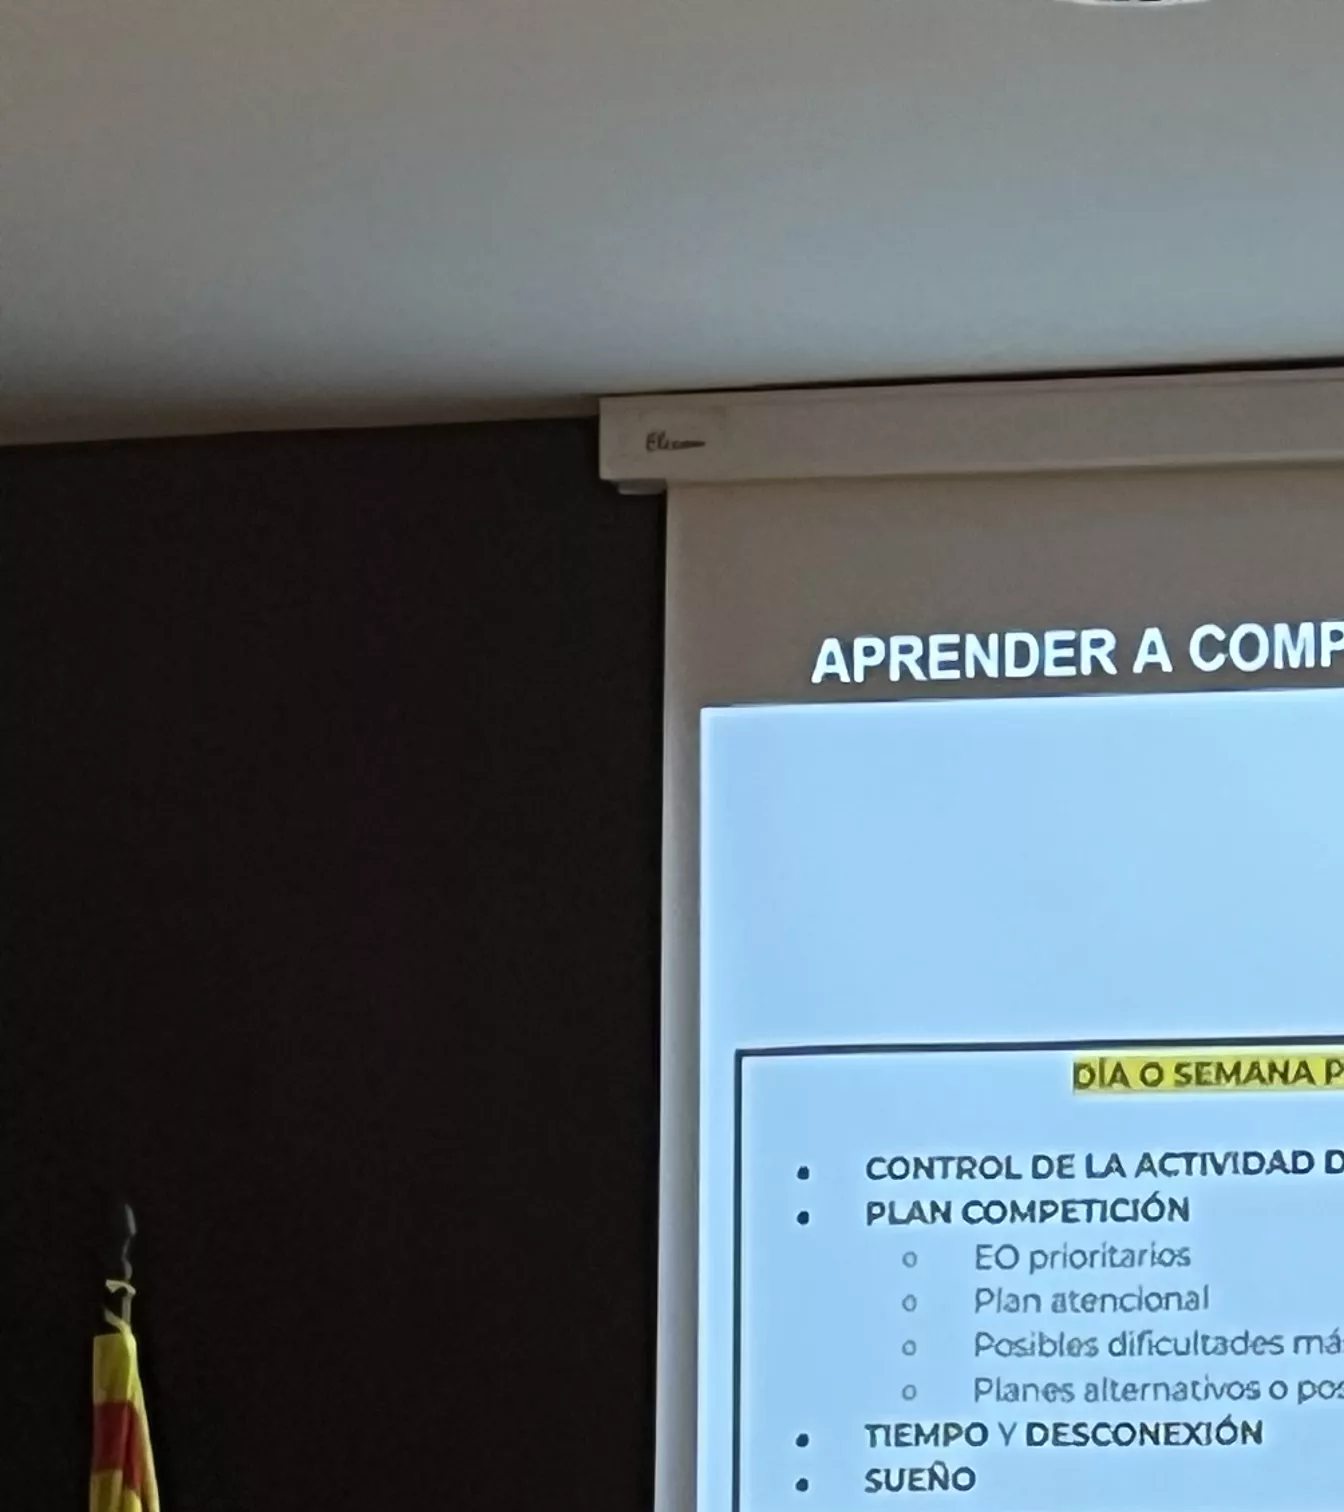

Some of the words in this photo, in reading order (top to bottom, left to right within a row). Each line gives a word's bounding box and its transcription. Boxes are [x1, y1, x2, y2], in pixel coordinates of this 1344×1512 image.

[810, 628, 1118, 684] APRENDER
[1132, 626, 1173, 674] A
[1072, 1060, 1130, 1090] DÍA
[1139, 1061, 1164, 1088] O
[1173, 1059, 1316, 1086] SEMANA
[865, 1154, 1024, 1182] CONTROL
[1030, 1152, 1077, 1182] DE
[1084, 1151, 1128, 1180] LA
[1133, 1148, 1316, 1180] ACTIVIDAD
[865, 1198, 954, 1227] PLAN
[960, 1189, 1191, 1227] COMPETICIÓN
[974, 1242, 1022, 1272] EO
[1027, 1239, 1192, 1276] prioritarios
[973, 1285, 1043, 1315] Plan
[1049, 1283, 1210, 1316] atencional
[973, 1329, 1101, 1360] Posibles
[1106, 1327, 1286, 1359] dificultades
[973, 1375, 1077, 1405] Planes
[1082, 1372, 1263, 1404] alternativos
[1267, 1378, 1290, 1402] o
[863, 1421, 990, 1449] TIEMPO
[997, 1421, 1018, 1448] Y
[1024, 1413, 1264, 1448] DESCONEXIÓN
[863, 1458, 978, 1495] SUEÑO
